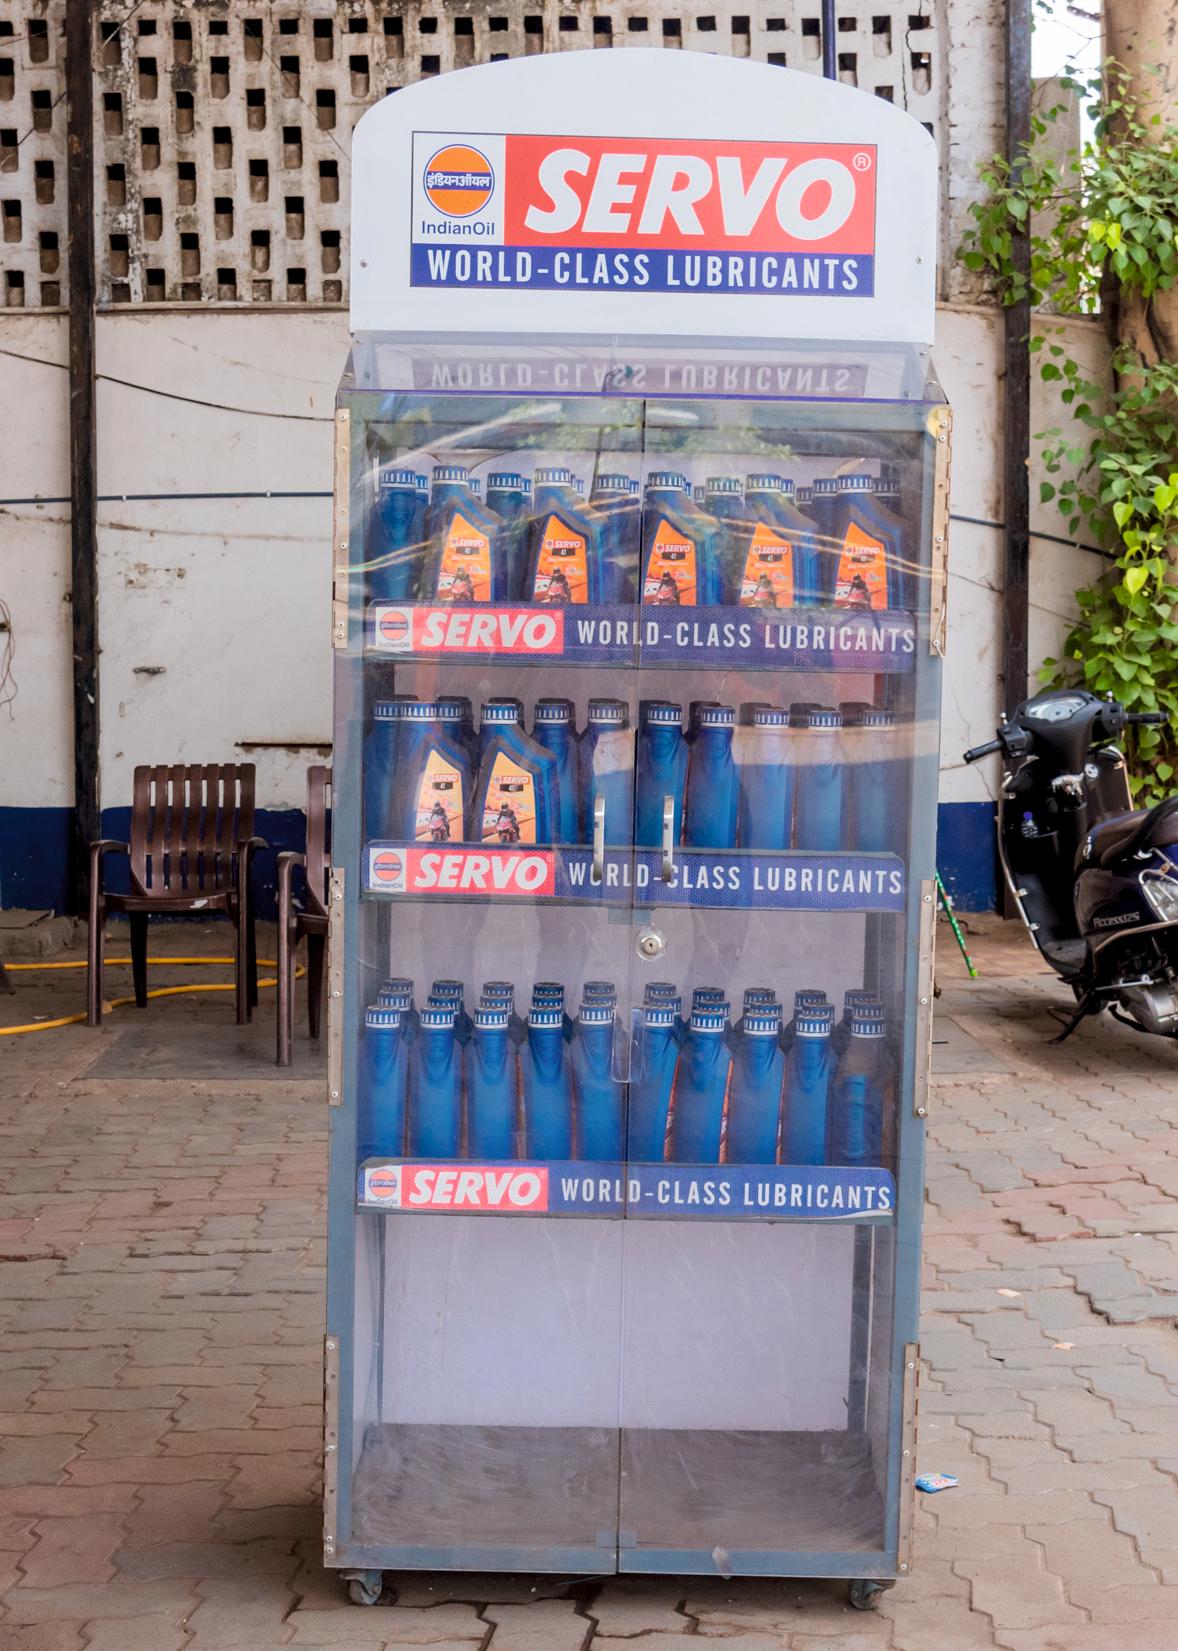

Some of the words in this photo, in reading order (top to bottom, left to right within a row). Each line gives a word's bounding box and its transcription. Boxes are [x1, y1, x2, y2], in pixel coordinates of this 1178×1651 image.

[427, 172, 491, 188] इंडियनऑयल
[524, 148, 856, 241] SERVO
[421, 221, 495, 236] IndianOil
[427, 250, 650, 286] WORLD-CLASS
[666, 254, 859, 290] LUBRICANTS
[665, 544, 691, 553] SERVO
[420, 611, 556, 648] SERVO
[577, 620, 752, 648] WORLD-CLASS
[764, 624, 915, 653] LUBRICANTS
[414, 853, 548, 890] SERVO
[753, 867, 902, 895] LUBRICANTS
[409, 1170, 541, 1206] SERVO
[561, 1178, 732, 1206] WORLD-CLASS
[743, 1182, 891, 1210] LUBRICANTS
